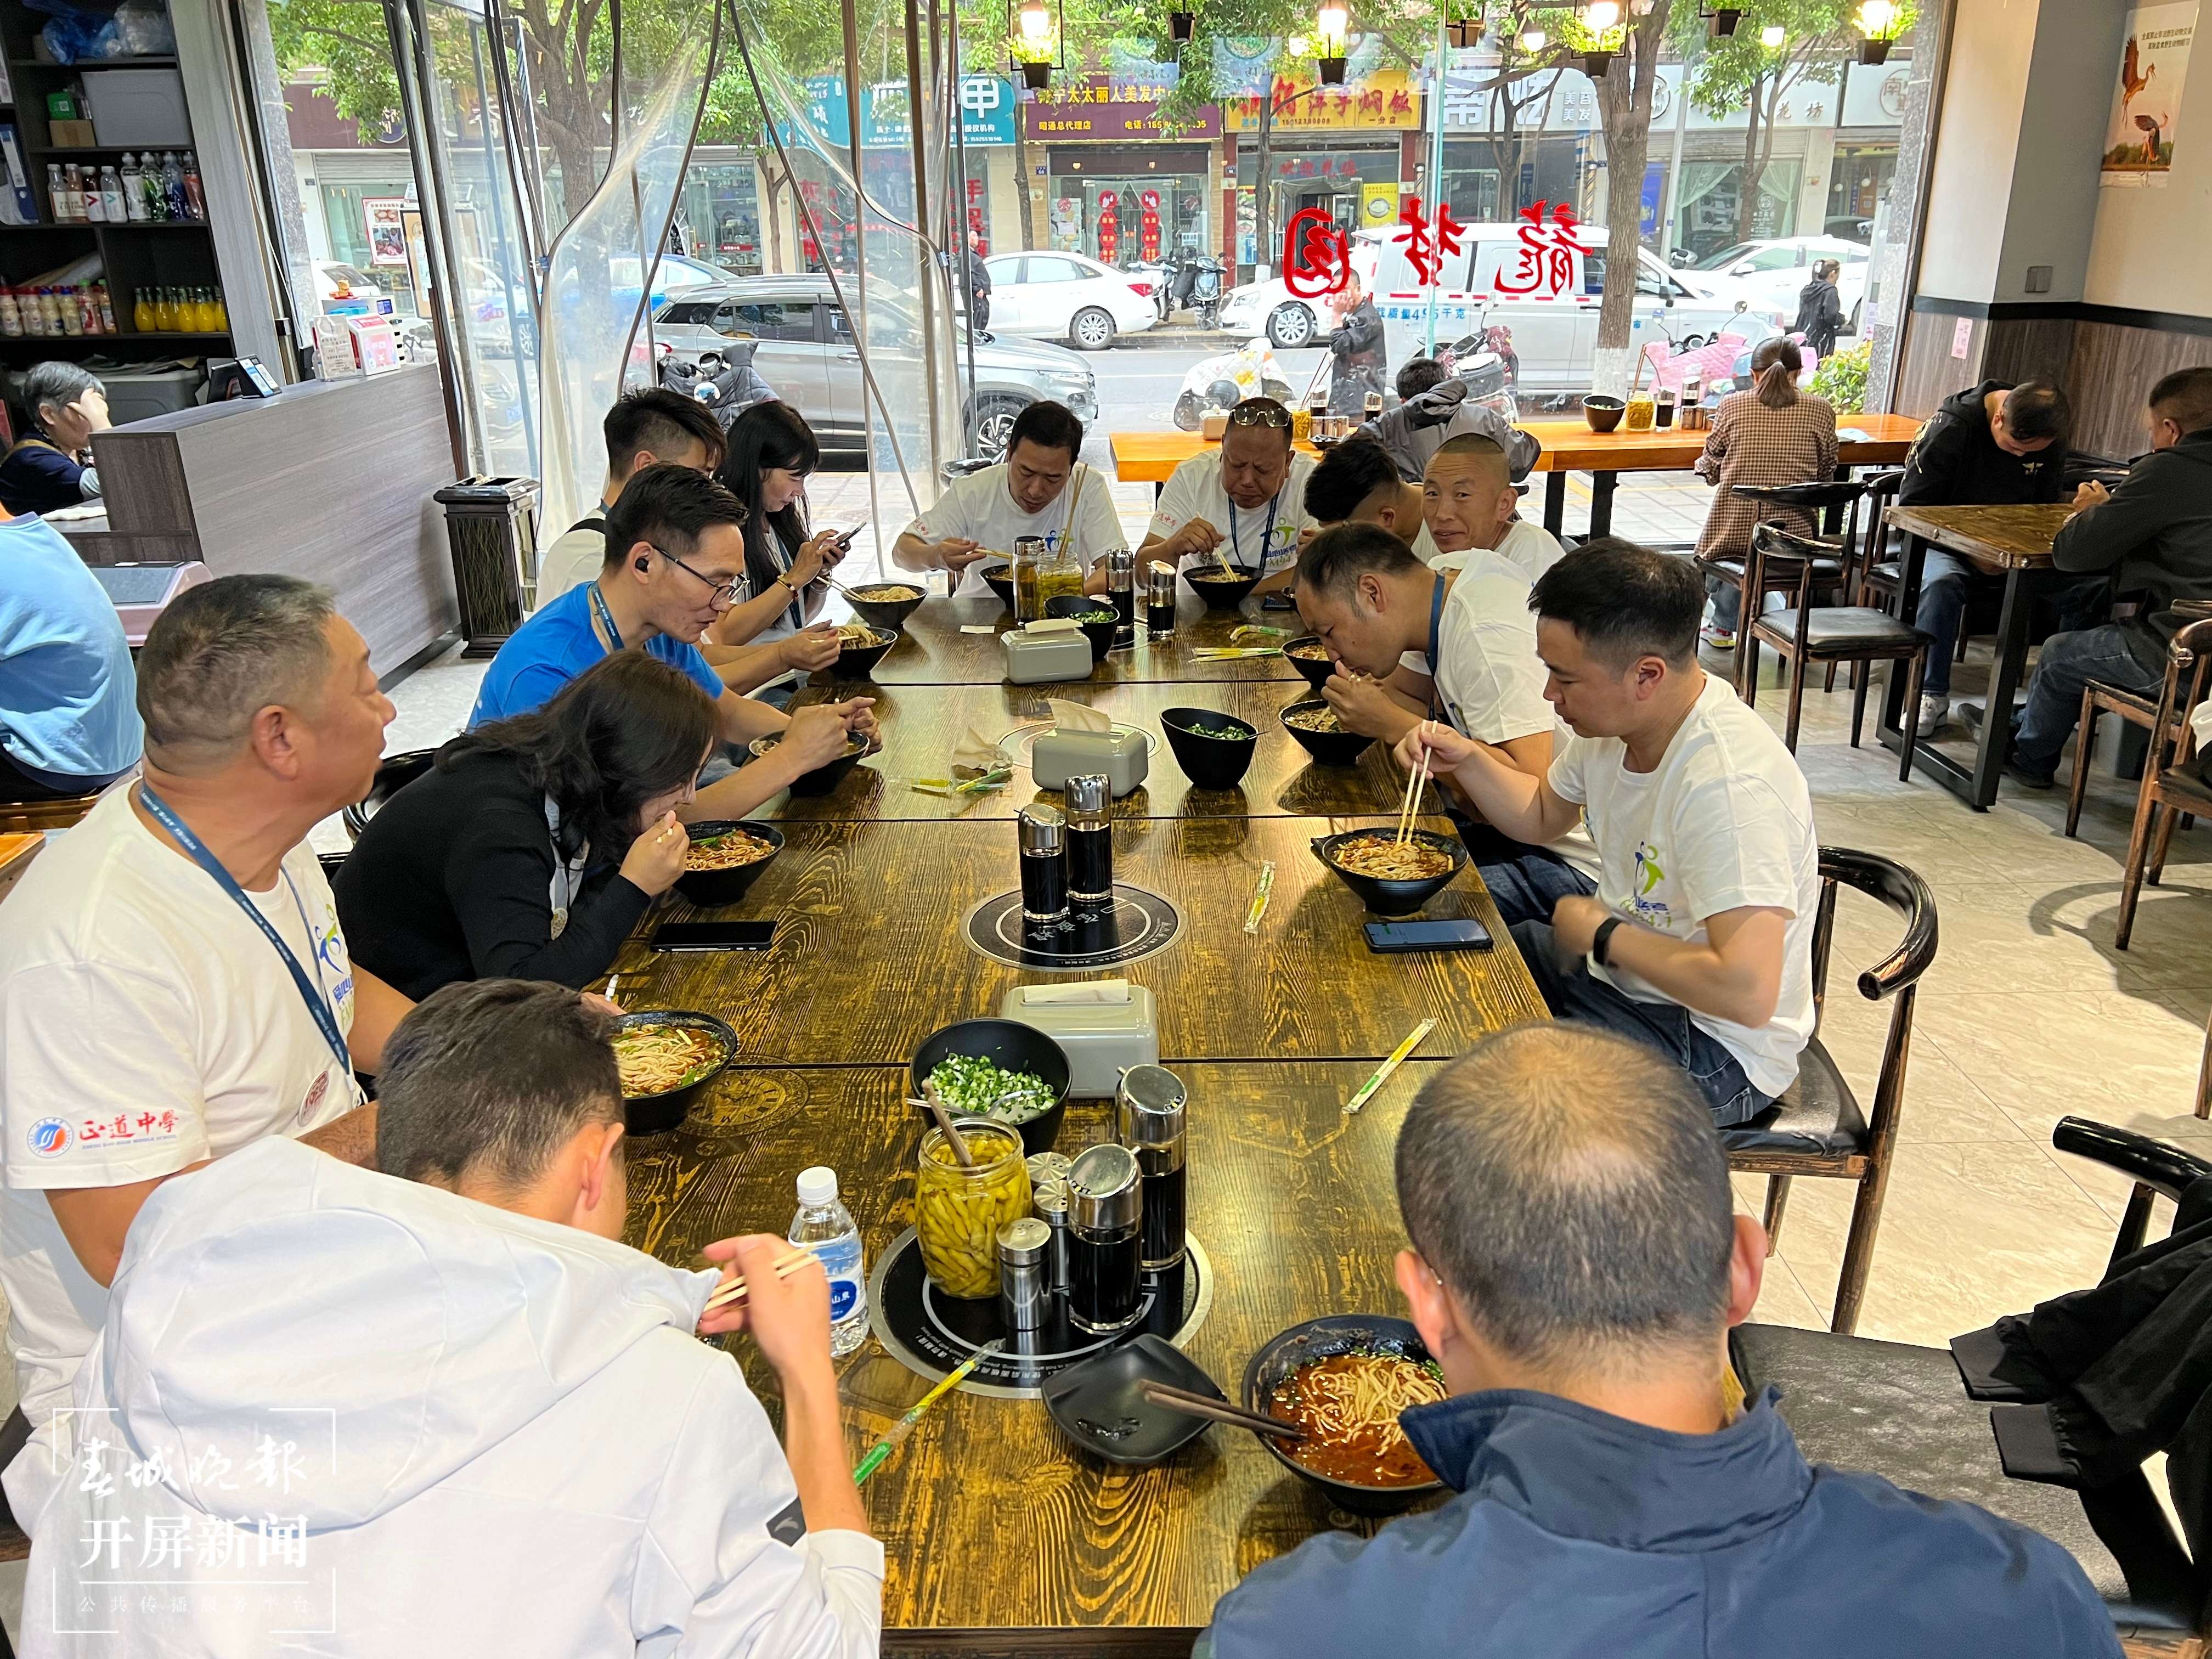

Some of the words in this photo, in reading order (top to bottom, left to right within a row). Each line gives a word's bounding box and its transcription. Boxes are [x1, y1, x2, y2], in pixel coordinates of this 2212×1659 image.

[962, 78, 1000, 119] 甲
[1564, 92, 1592, 105] 美容
[1368, 116, 1397, 125] 一分店
[1563, 109, 1592, 121] 美发
[950, 124, 996, 133] 合授权机构
[1039, 121, 1092, 131] 昭通总代理店
